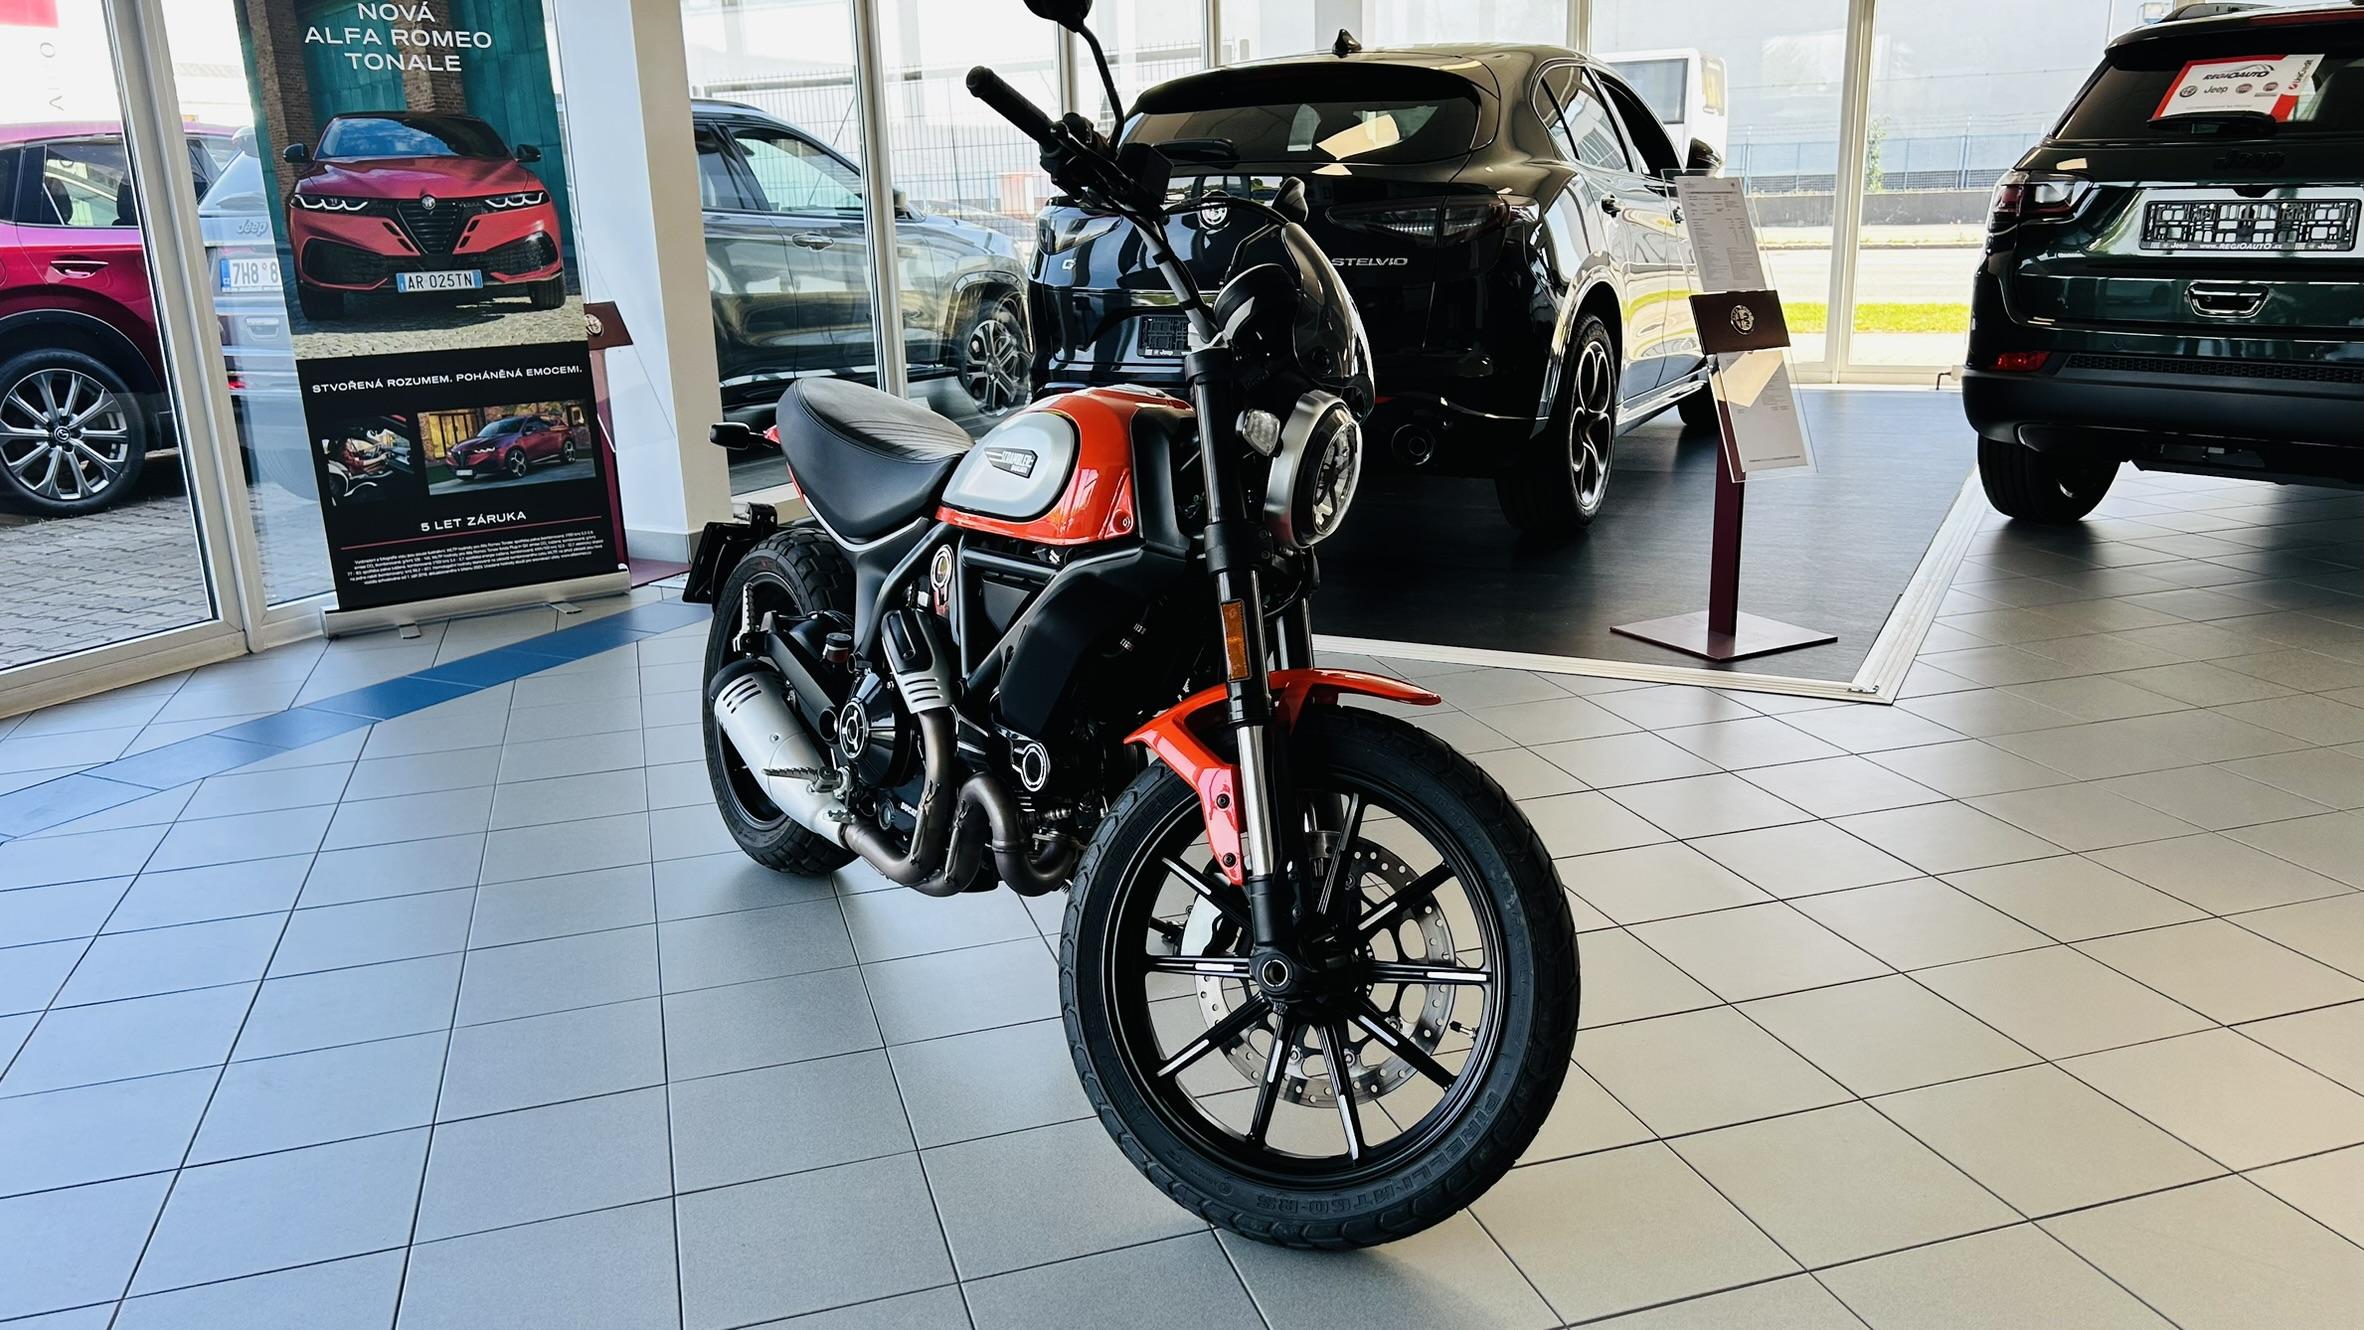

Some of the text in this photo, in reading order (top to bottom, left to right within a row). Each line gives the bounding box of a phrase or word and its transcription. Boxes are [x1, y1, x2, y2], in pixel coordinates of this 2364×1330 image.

[357, 2, 436, 22] NOVÁ
[304, 26, 493, 49] ALFA ROMEO
[344, 52, 463, 72] TONALE
[2203, 86, 2228, 94] Jeep
[236, 219, 269, 237] Jeep
[1331, 257, 1409, 267] STELVIO
[232, 262, 260, 285] 7H8
[407, 272, 473, 290] AR 025TN
[311, 365, 583, 394] STVOŘENÁ ROZUMEM. POHÁNĚNÁ EMOCEMI.
[420, 511, 527, 532] 5 LET ZÁRUKA
